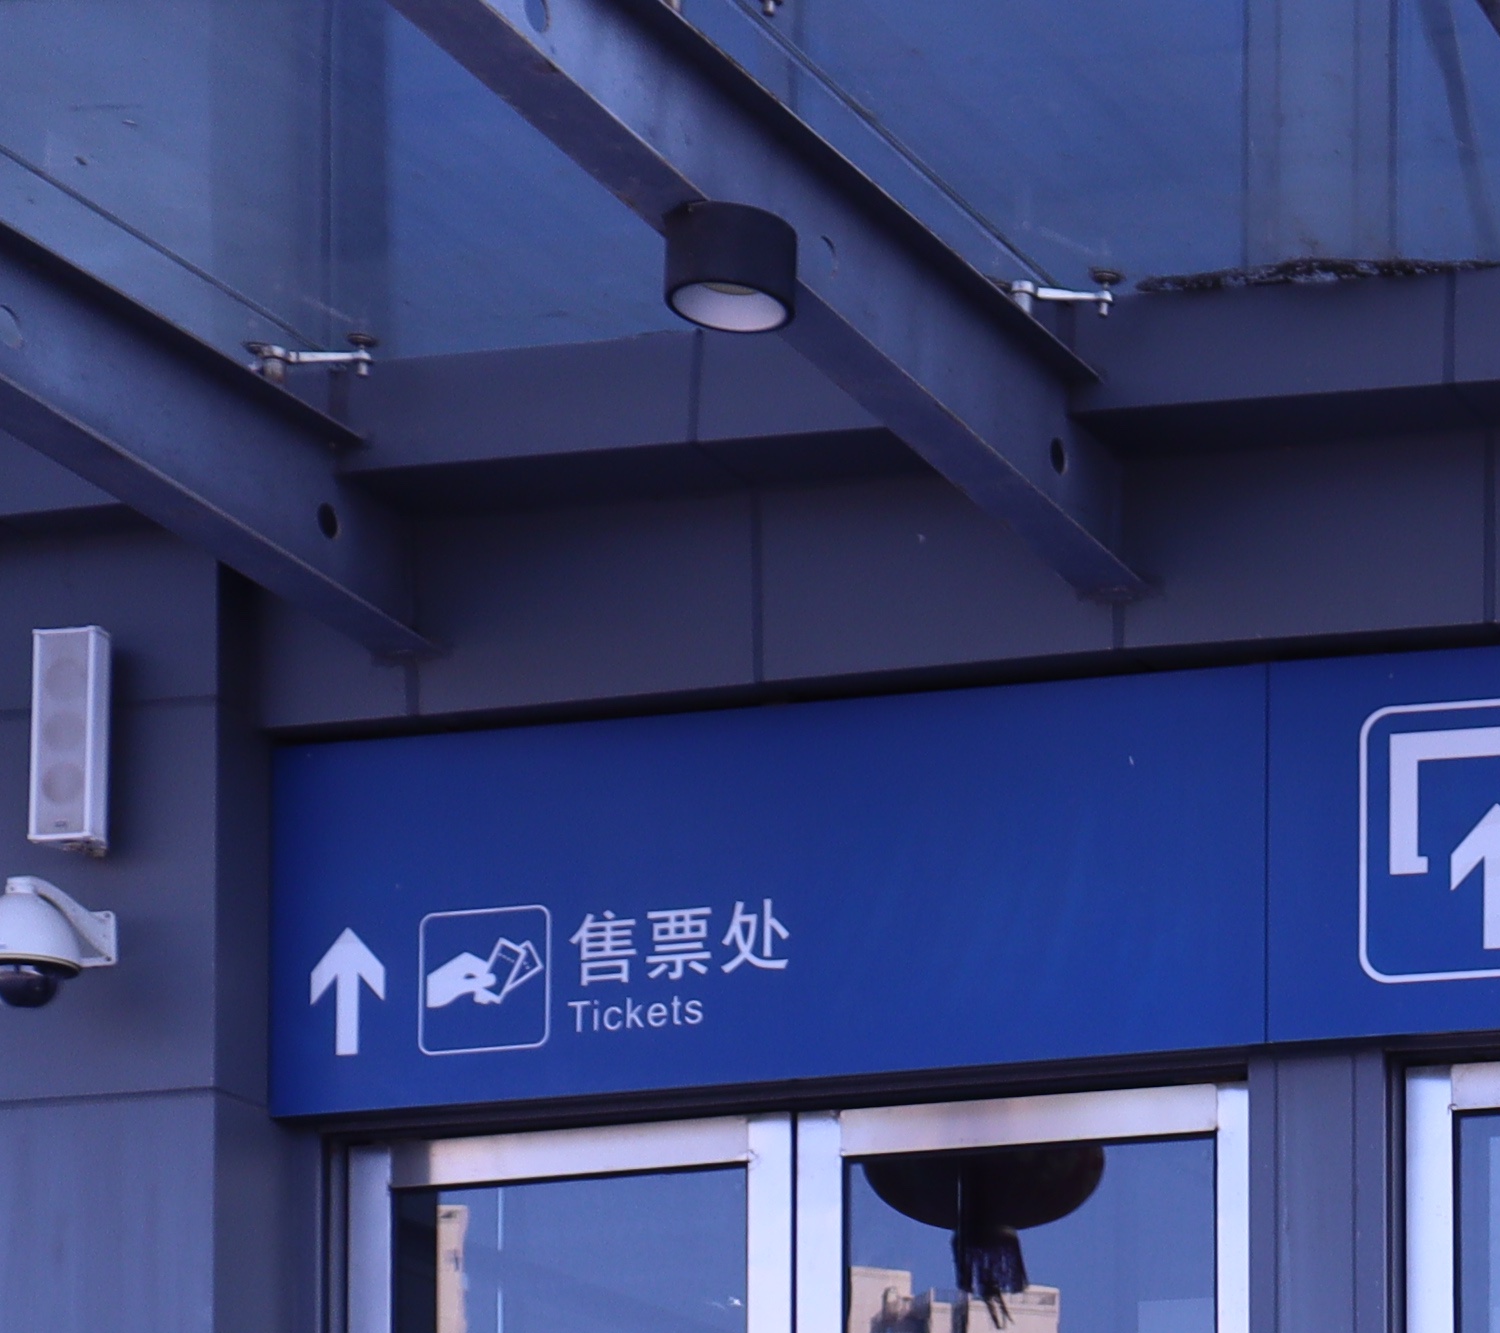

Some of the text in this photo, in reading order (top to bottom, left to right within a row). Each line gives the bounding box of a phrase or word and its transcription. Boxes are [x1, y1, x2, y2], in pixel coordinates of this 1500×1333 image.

[569, 898, 792, 987] 售票处
[567, 992, 704, 1034] Tickets
